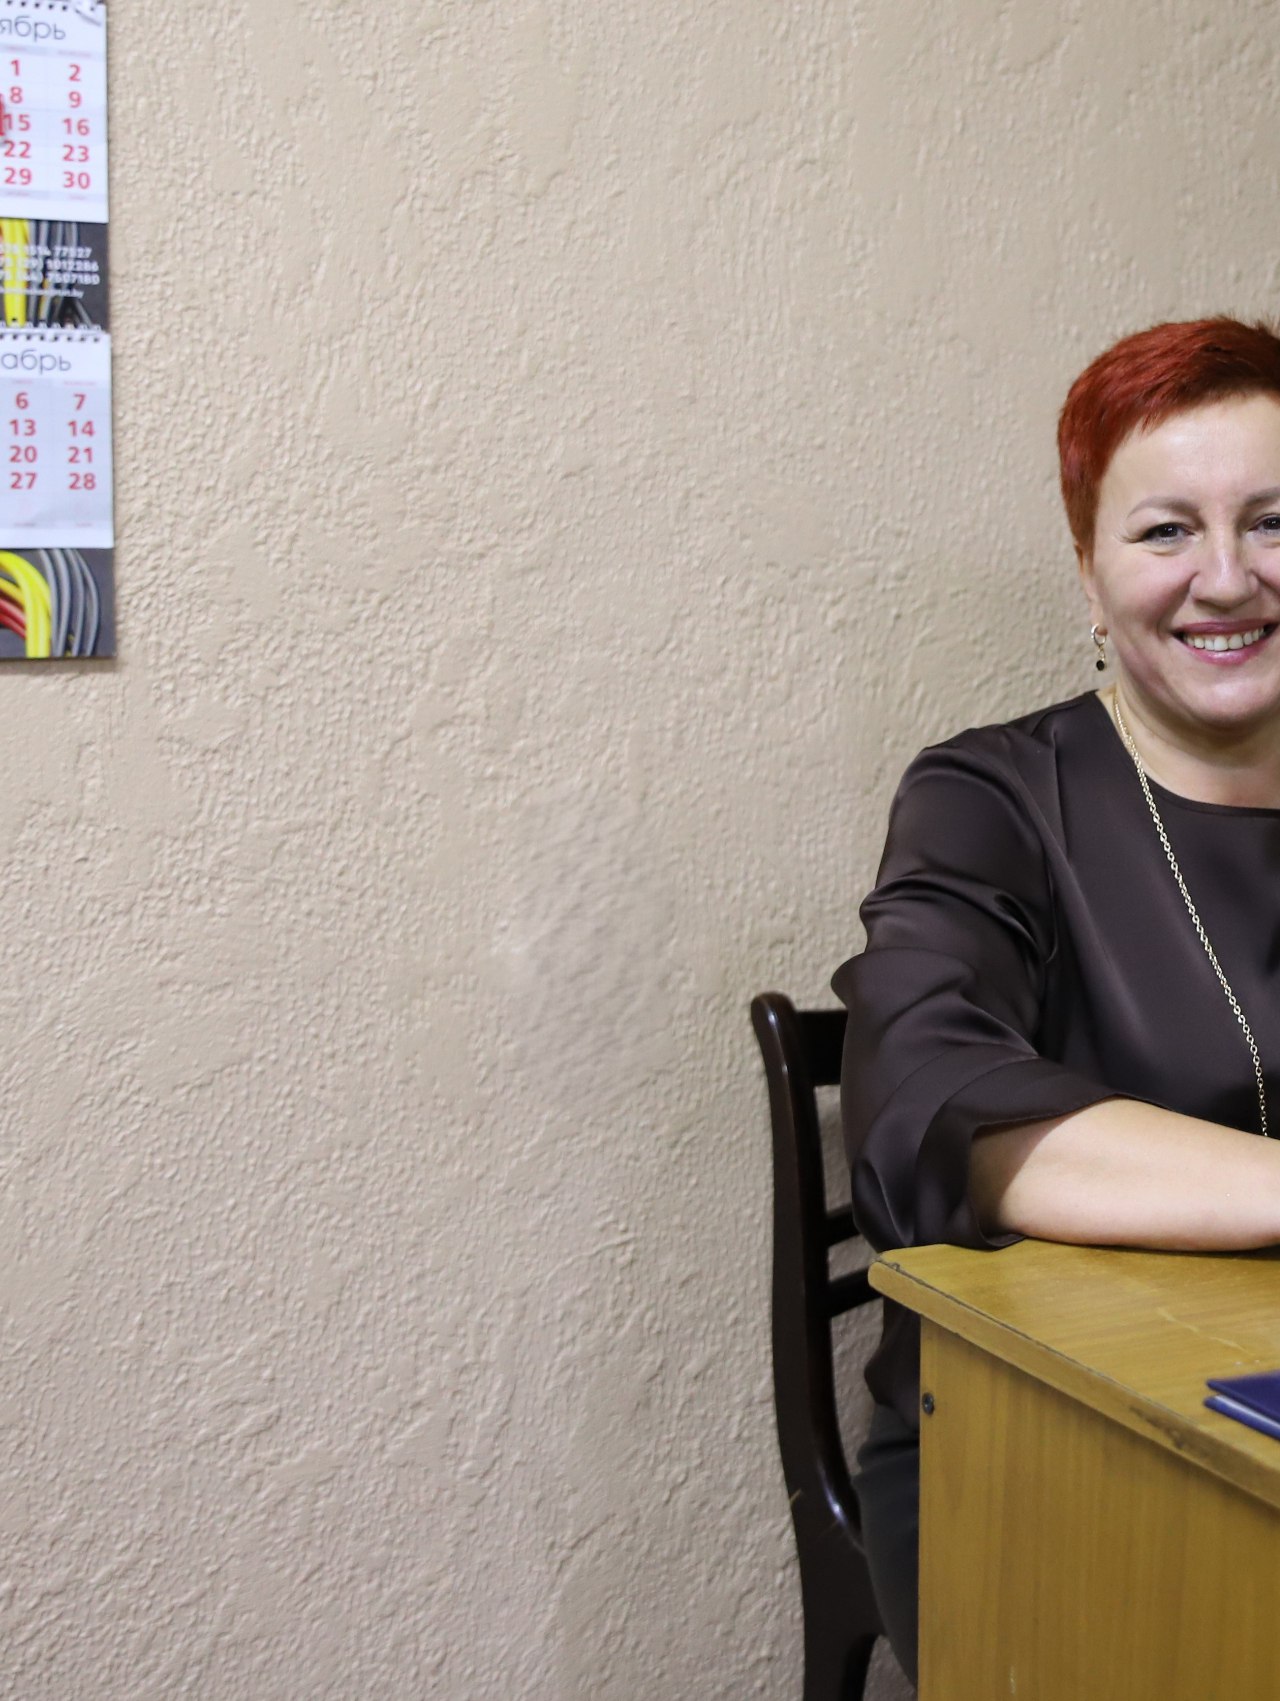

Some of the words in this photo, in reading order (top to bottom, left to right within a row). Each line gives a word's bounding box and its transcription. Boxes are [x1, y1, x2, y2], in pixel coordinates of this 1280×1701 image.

[10, 59, 20, 77] 1
[68, 64, 81, 82] 2
[9, 86, 23, 105] 8
[68, 91, 82, 109] 9
[3, 113, 32, 132] 15
[63, 117, 90, 136] 16
[3, 139, 32, 159] 22
[62, 144, 90, 163] 23
[4, 166, 32, 186] 29
[63, 171, 91, 190] 30
[1, 349, 72, 375] абрь
[15, 391, 29, 410] 6
[72, 393, 87, 411] 7
[9, 418, 37, 436] 13
[68, 420, 96, 437] 14
[9, 445, 38, 464] 20
[68, 448, 94, 465] 21
[10, 471, 38, 489] 27
[68, 472, 96, 491] 28
